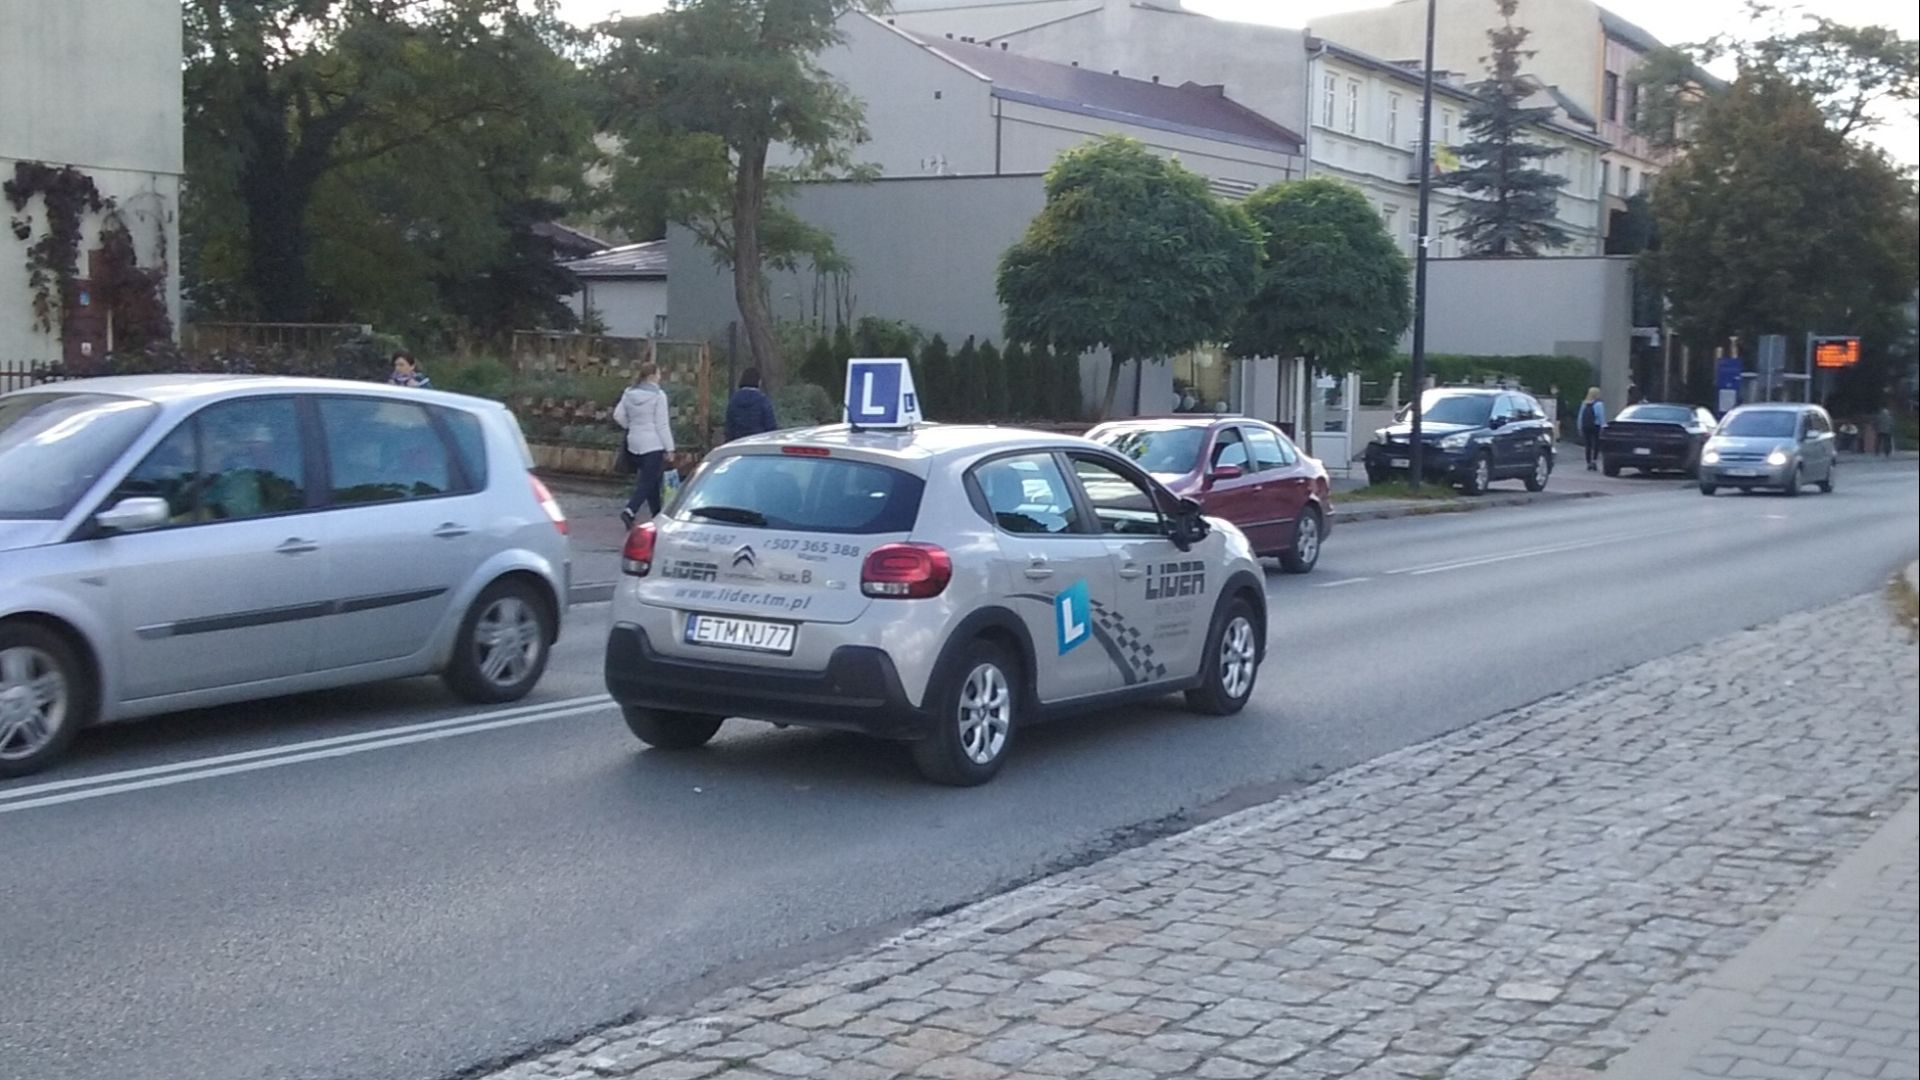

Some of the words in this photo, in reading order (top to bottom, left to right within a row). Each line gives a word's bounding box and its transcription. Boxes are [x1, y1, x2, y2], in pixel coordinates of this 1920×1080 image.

[862, 372, 885, 415] L
[905, 395, 914, 410] L
[771, 538, 799, 550] 507
[800, 540, 830, 553] 365
[831, 543, 860, 557] 388
[661, 560, 718, 582] LIDER
[801, 569, 812, 584] B
[1145, 561, 1205, 600] LIDER
[675, 588, 812, 611] www.lider.tm.pl
[1062, 597, 1085, 644] L
[697, 618, 740, 643] ETM
[743, 623, 791, 649] NJ77
